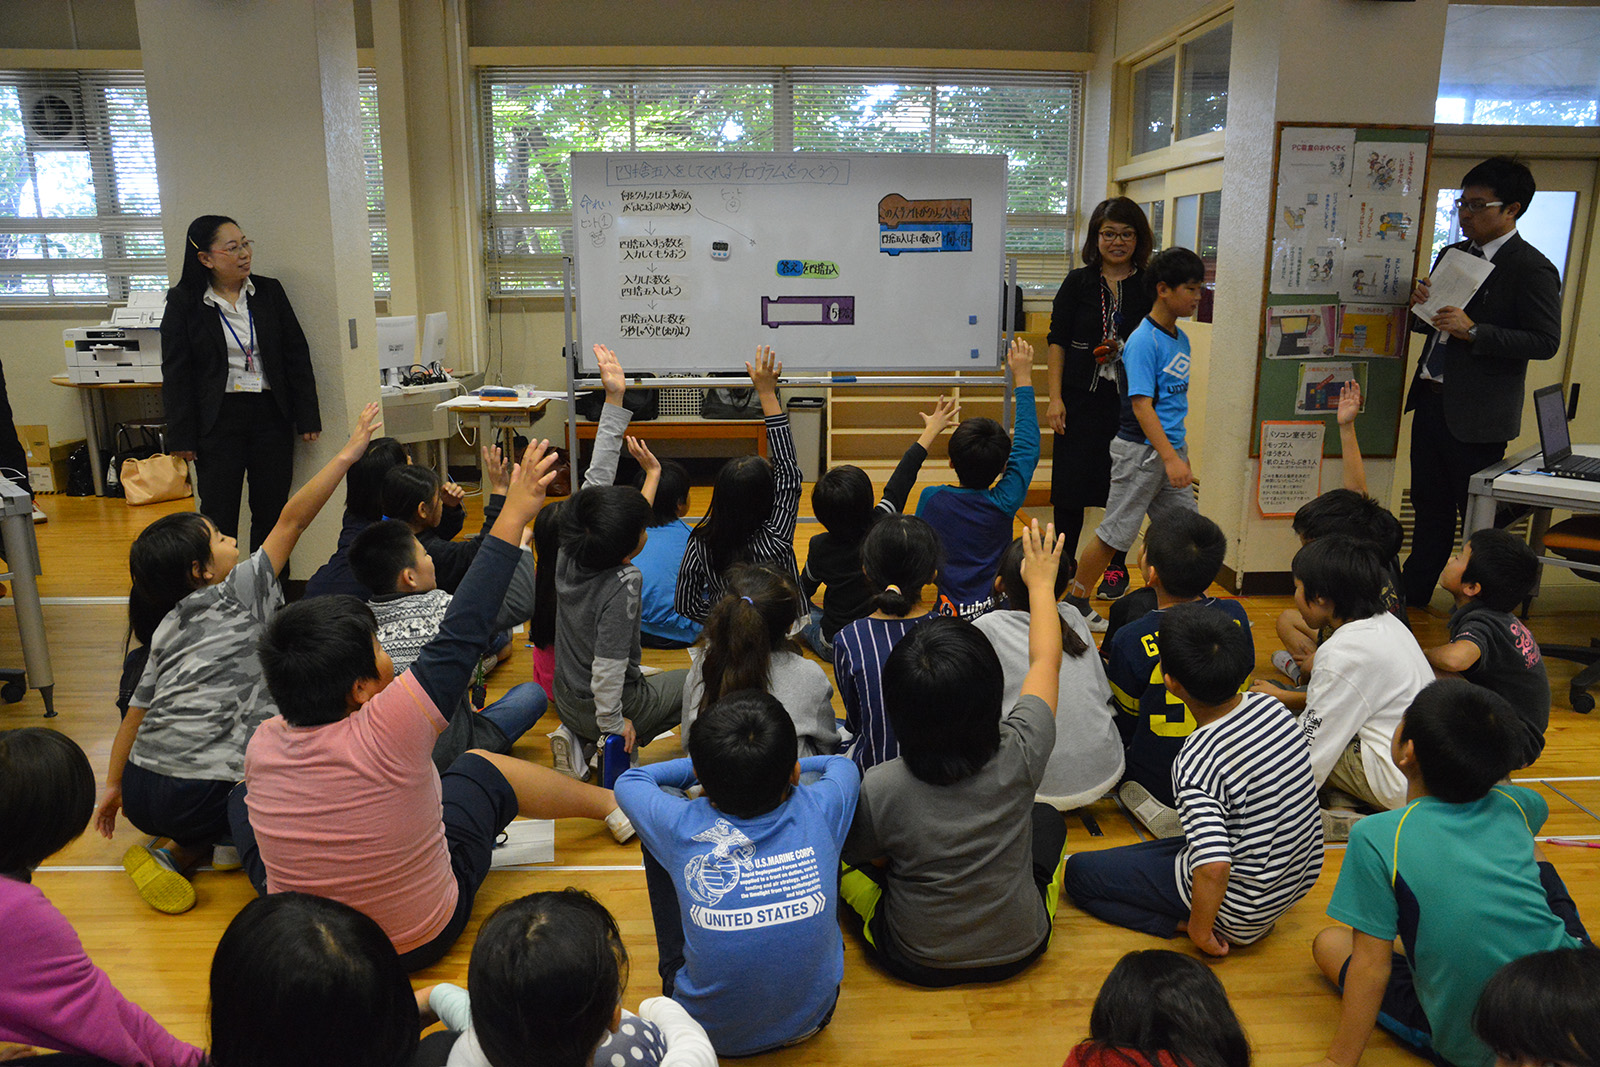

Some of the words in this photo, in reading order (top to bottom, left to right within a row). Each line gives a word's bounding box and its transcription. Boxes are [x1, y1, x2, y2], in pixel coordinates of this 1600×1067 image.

[794, 846, 815, 860] CORPS
[704, 912, 753, 927] UNITED
[756, 901, 809, 923] STATES
